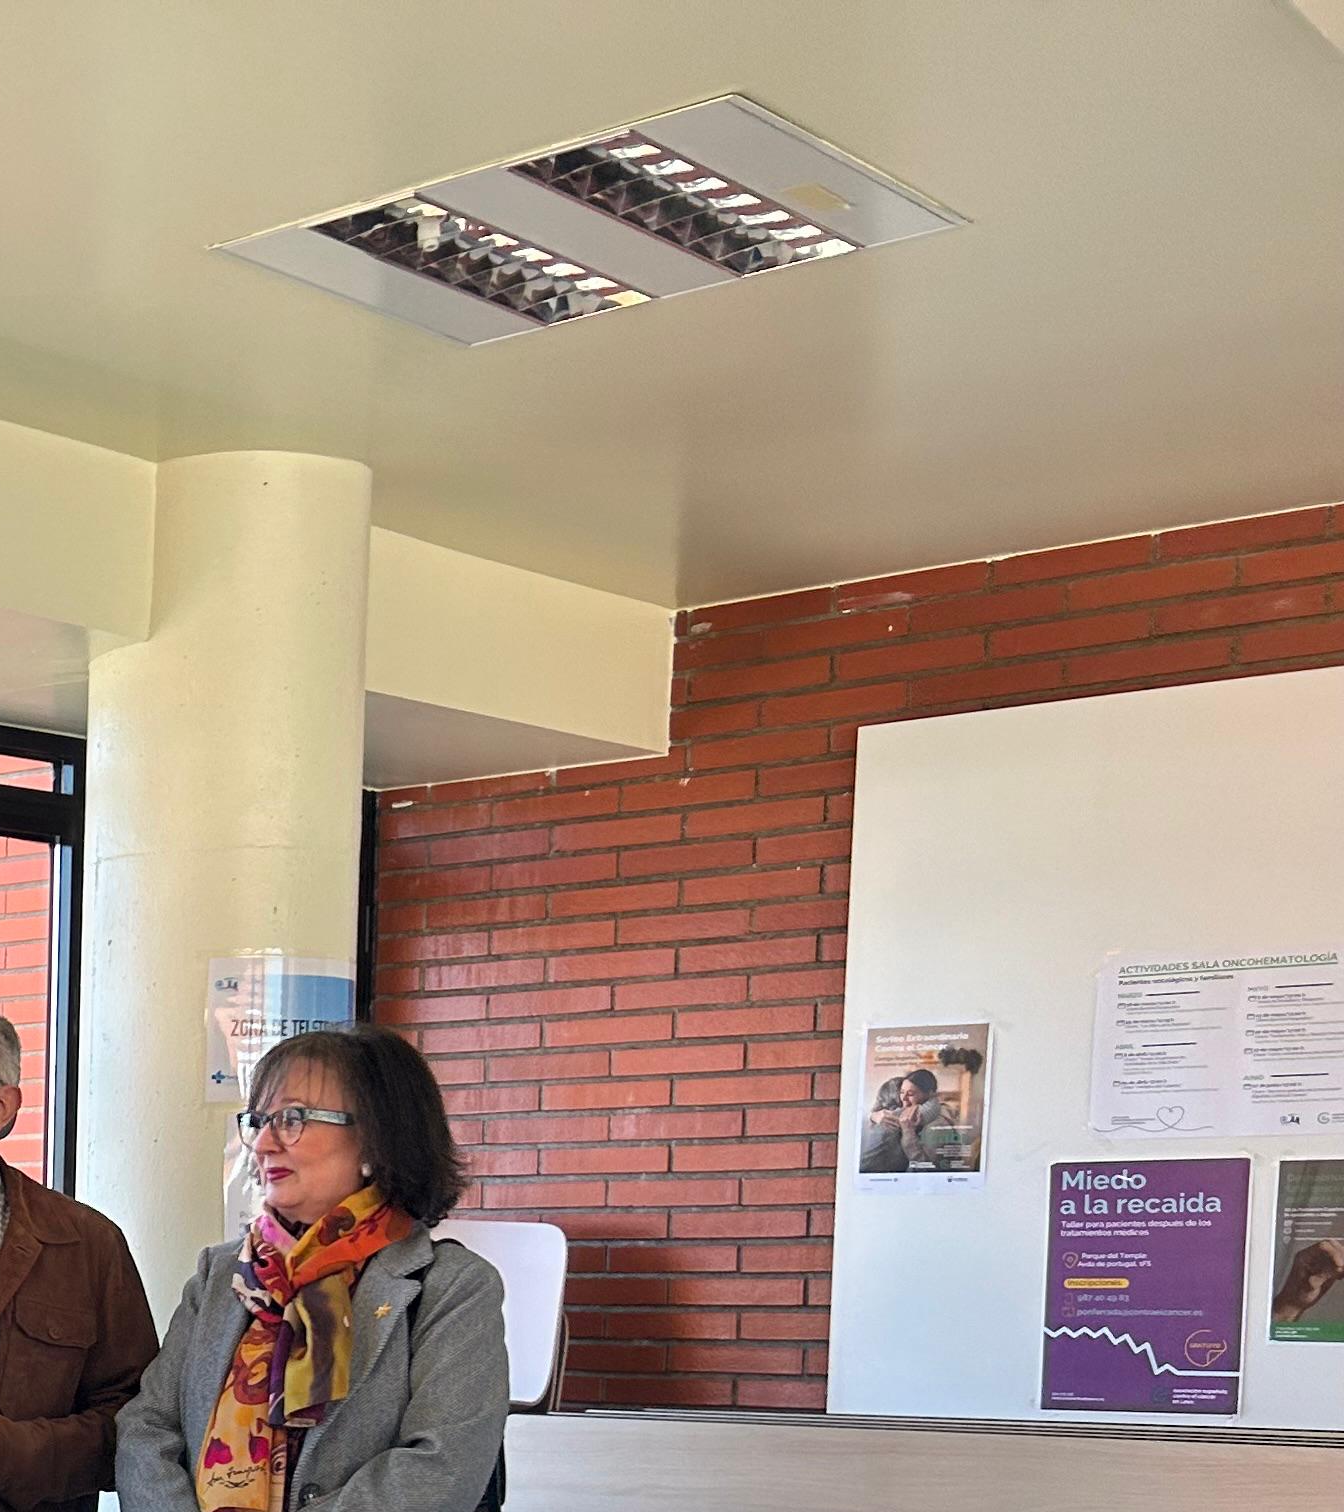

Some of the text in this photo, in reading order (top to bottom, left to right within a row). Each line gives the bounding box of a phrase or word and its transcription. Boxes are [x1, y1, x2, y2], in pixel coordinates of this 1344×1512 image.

[1118, 952, 1338, 974] ACTIVIDADES SALA ONCOHEMATOLOGÍA
[1061, 1168, 1147, 1191] Miedo
[1060, 1192, 1222, 1215] a la recaida
[1061, 1220, 1084, 1228] Taller
[1085, 1221, 1105, 1229] para
[1105, 1220, 1147, 1228] pacientes
